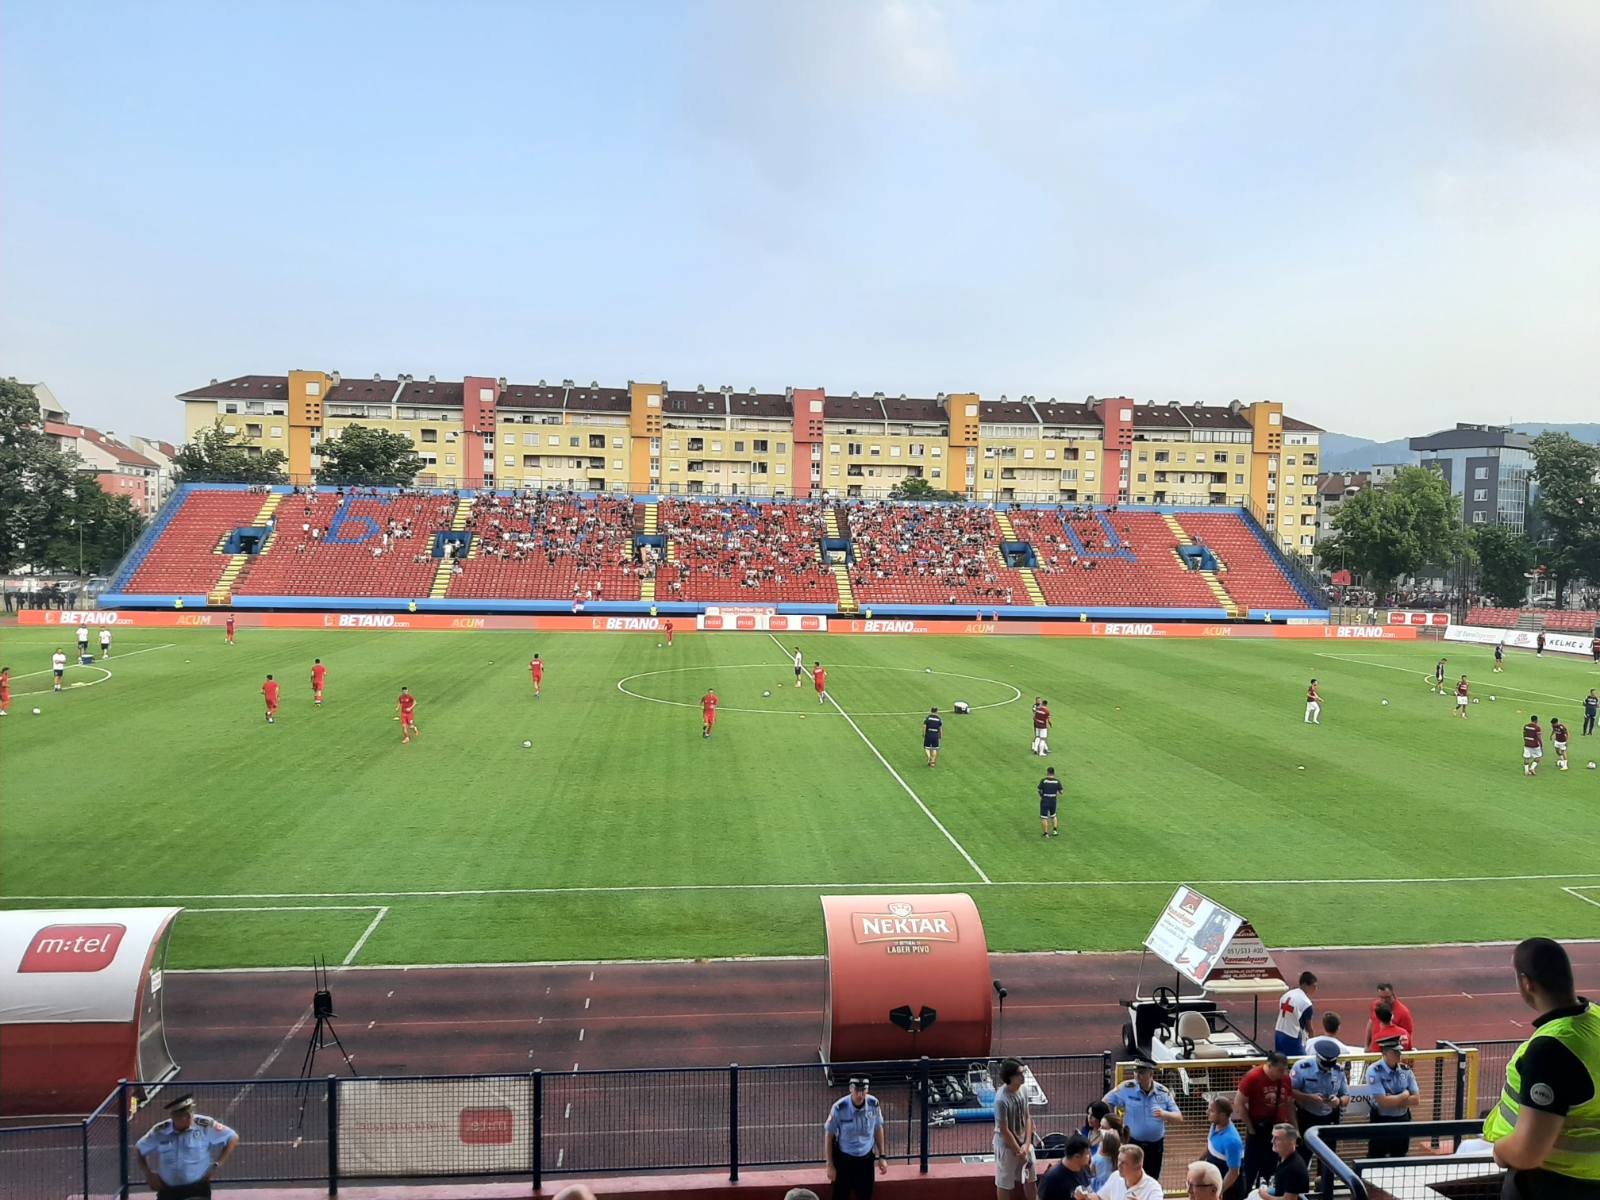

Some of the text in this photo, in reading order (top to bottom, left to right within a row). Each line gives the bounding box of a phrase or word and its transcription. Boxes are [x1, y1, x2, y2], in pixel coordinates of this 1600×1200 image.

[177, 615, 211, 626] ACUM
[452, 618, 485, 628] ACUM
[1549, 639, 1577, 649] KELME
[862, 917, 950, 935] NEKTAR
[36, 933, 111, 956] m:tel
[912, 945, 930, 953] PIVO
